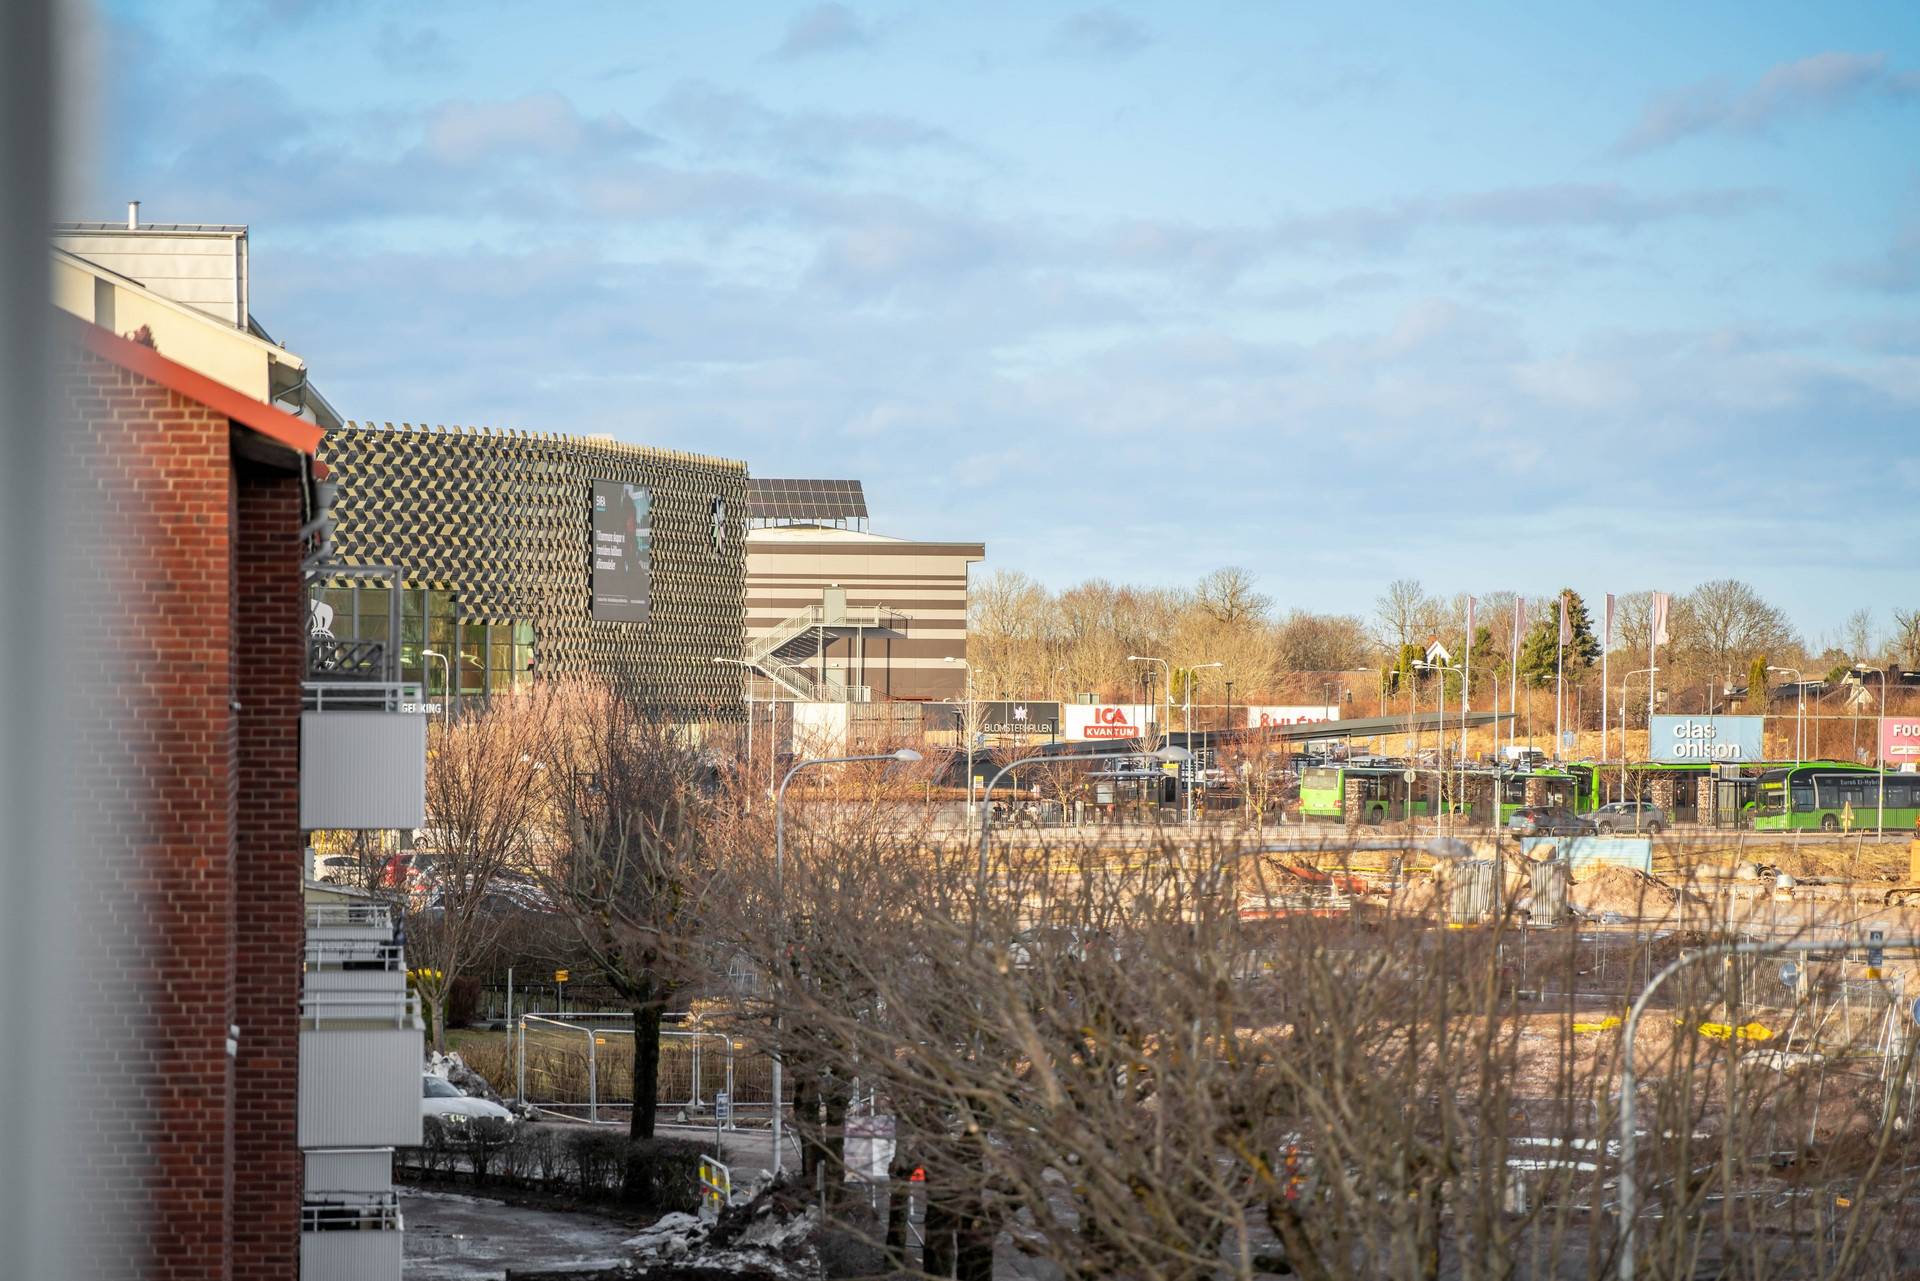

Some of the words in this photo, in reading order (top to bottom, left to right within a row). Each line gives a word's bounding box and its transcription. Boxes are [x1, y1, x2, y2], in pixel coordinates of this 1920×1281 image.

[420, 703, 442, 713] KING
[1095, 703, 1127, 724] ICA
[1086, 728, 1134, 736] KVANTUM
[1673, 719, 1716, 739] clas
[1673, 739, 1742, 758] ohlson
